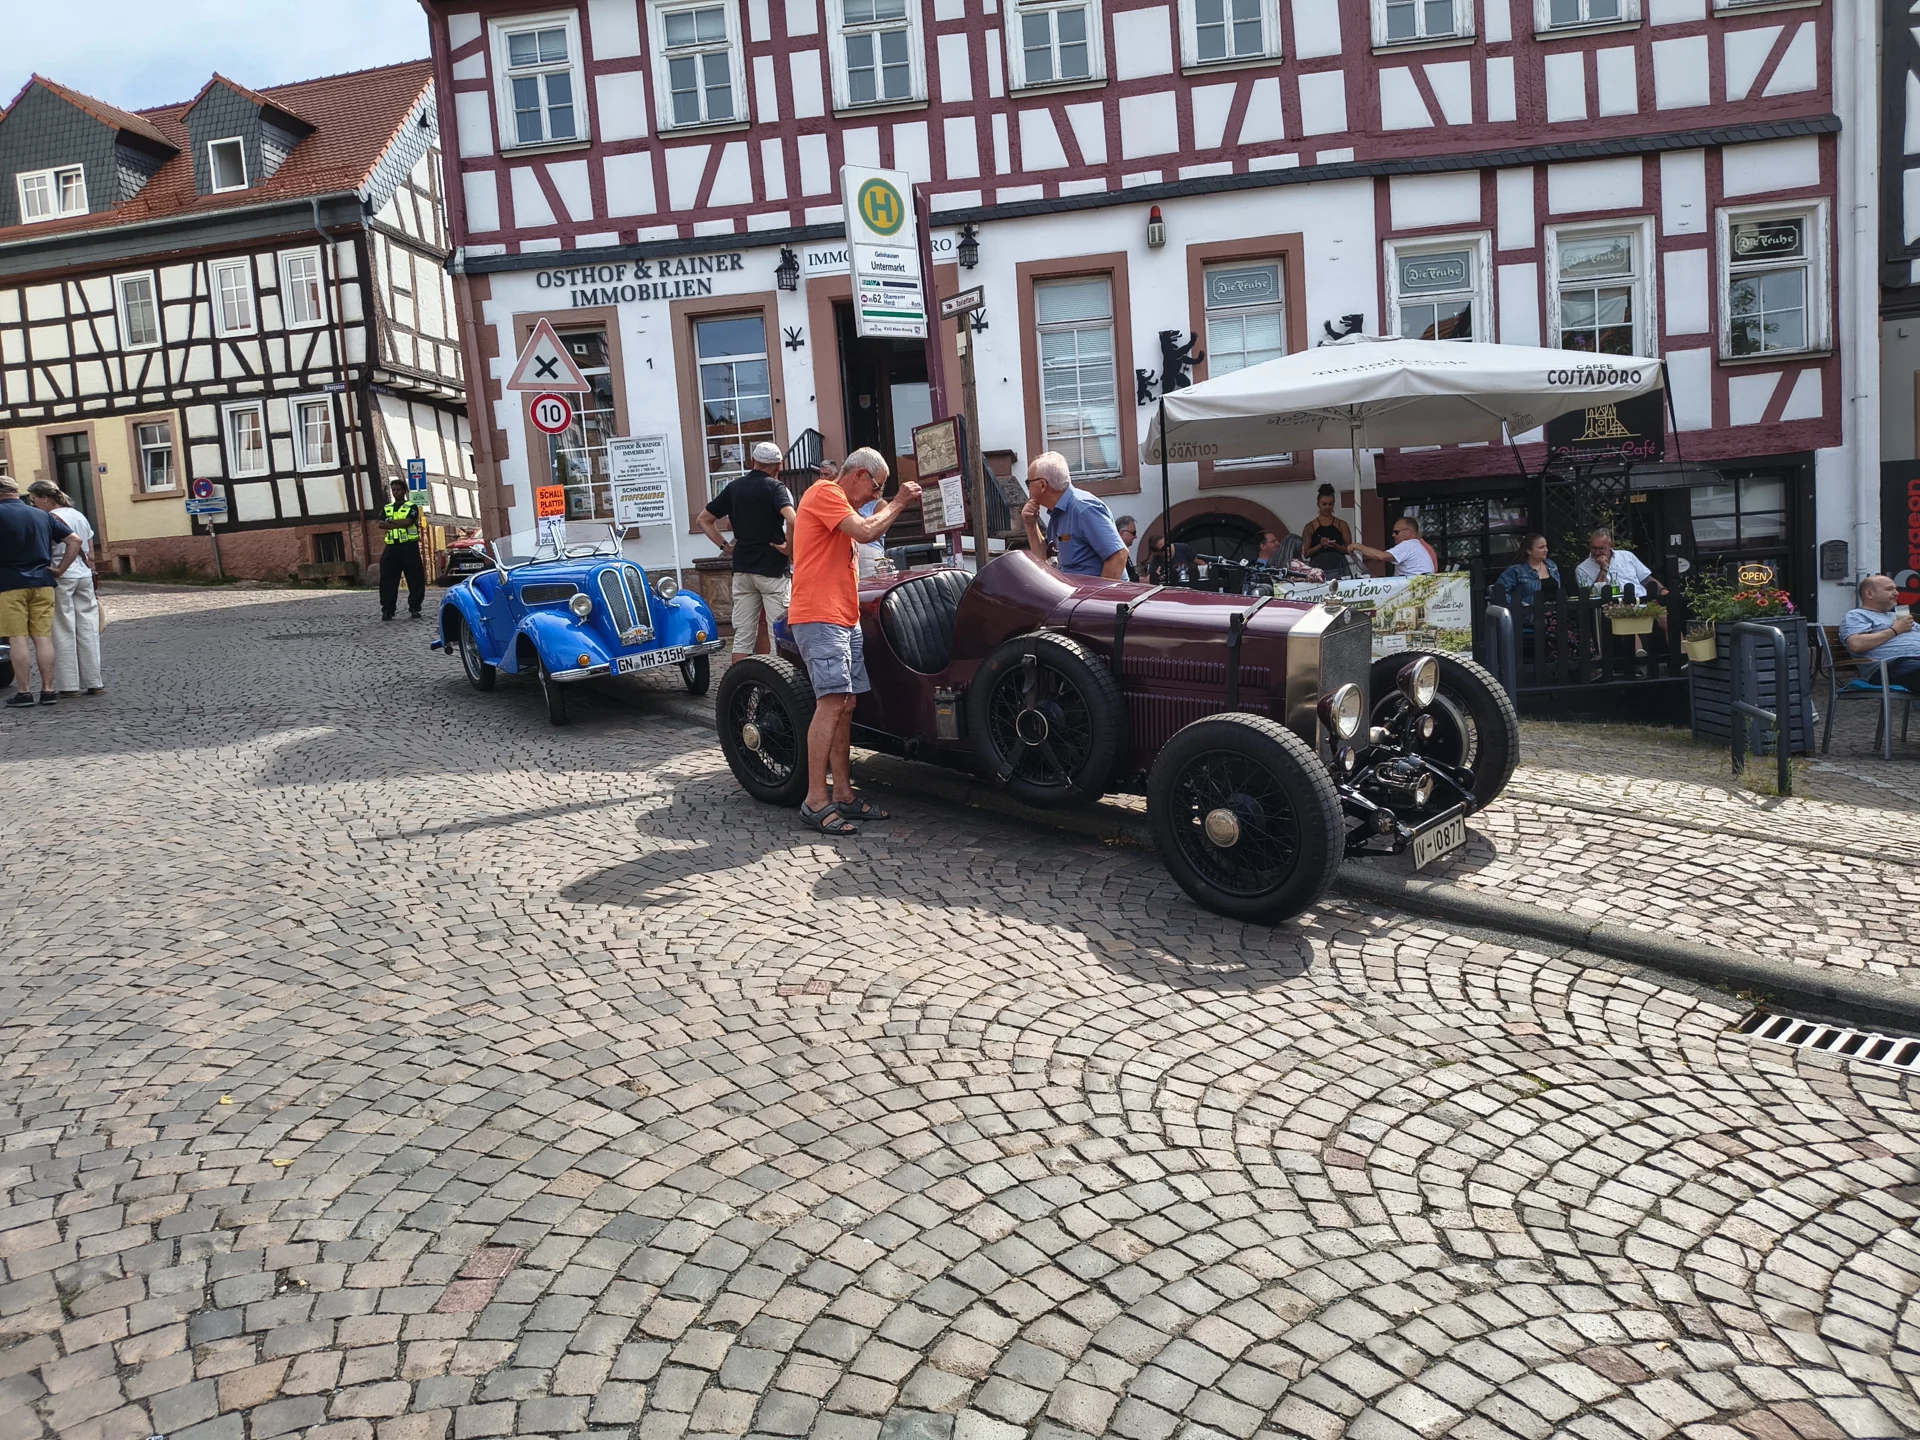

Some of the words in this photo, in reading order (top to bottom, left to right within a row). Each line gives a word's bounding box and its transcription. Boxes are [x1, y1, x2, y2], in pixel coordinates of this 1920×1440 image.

[869, 190, 893, 223] H
[874, 251, 900, 259] Gelnhausen
[535, 263, 628, 288] OSTHOF
[633, 257, 652, 280] &
[657, 252, 744, 278] RAINER
[870, 260, 906, 273] Untermarkt
[1408, 268, 1427, 282] Die
[1427, 266, 1461, 280] Truhe
[570, 277, 713, 307] IMMOBILIEN
[1217, 282, 1236, 294] Die
[1235, 279, 1268, 292] Truhe
[646, 357, 653, 370] 1
[1547, 369, 1642, 385] COSTADORO
[541, 404, 561, 423] 10
[614, 443, 636, 451] OSTHOF
[635, 441, 642, 449] &
[622, 448, 654, 456] IMMOBILIEN
[1621, 440, 1655, 458] Café
[622, 484, 662, 494] SCHNEIDEREI
[540, 500, 564, 508] PLATTEN
[620, 492, 665, 502] STOFFZAUBER
[1741, 571, 1767, 581] OPEN
[618, 658, 634, 672] GN
[640, 653, 656, 668] MH
[657, 648, 685, 664] 315H
